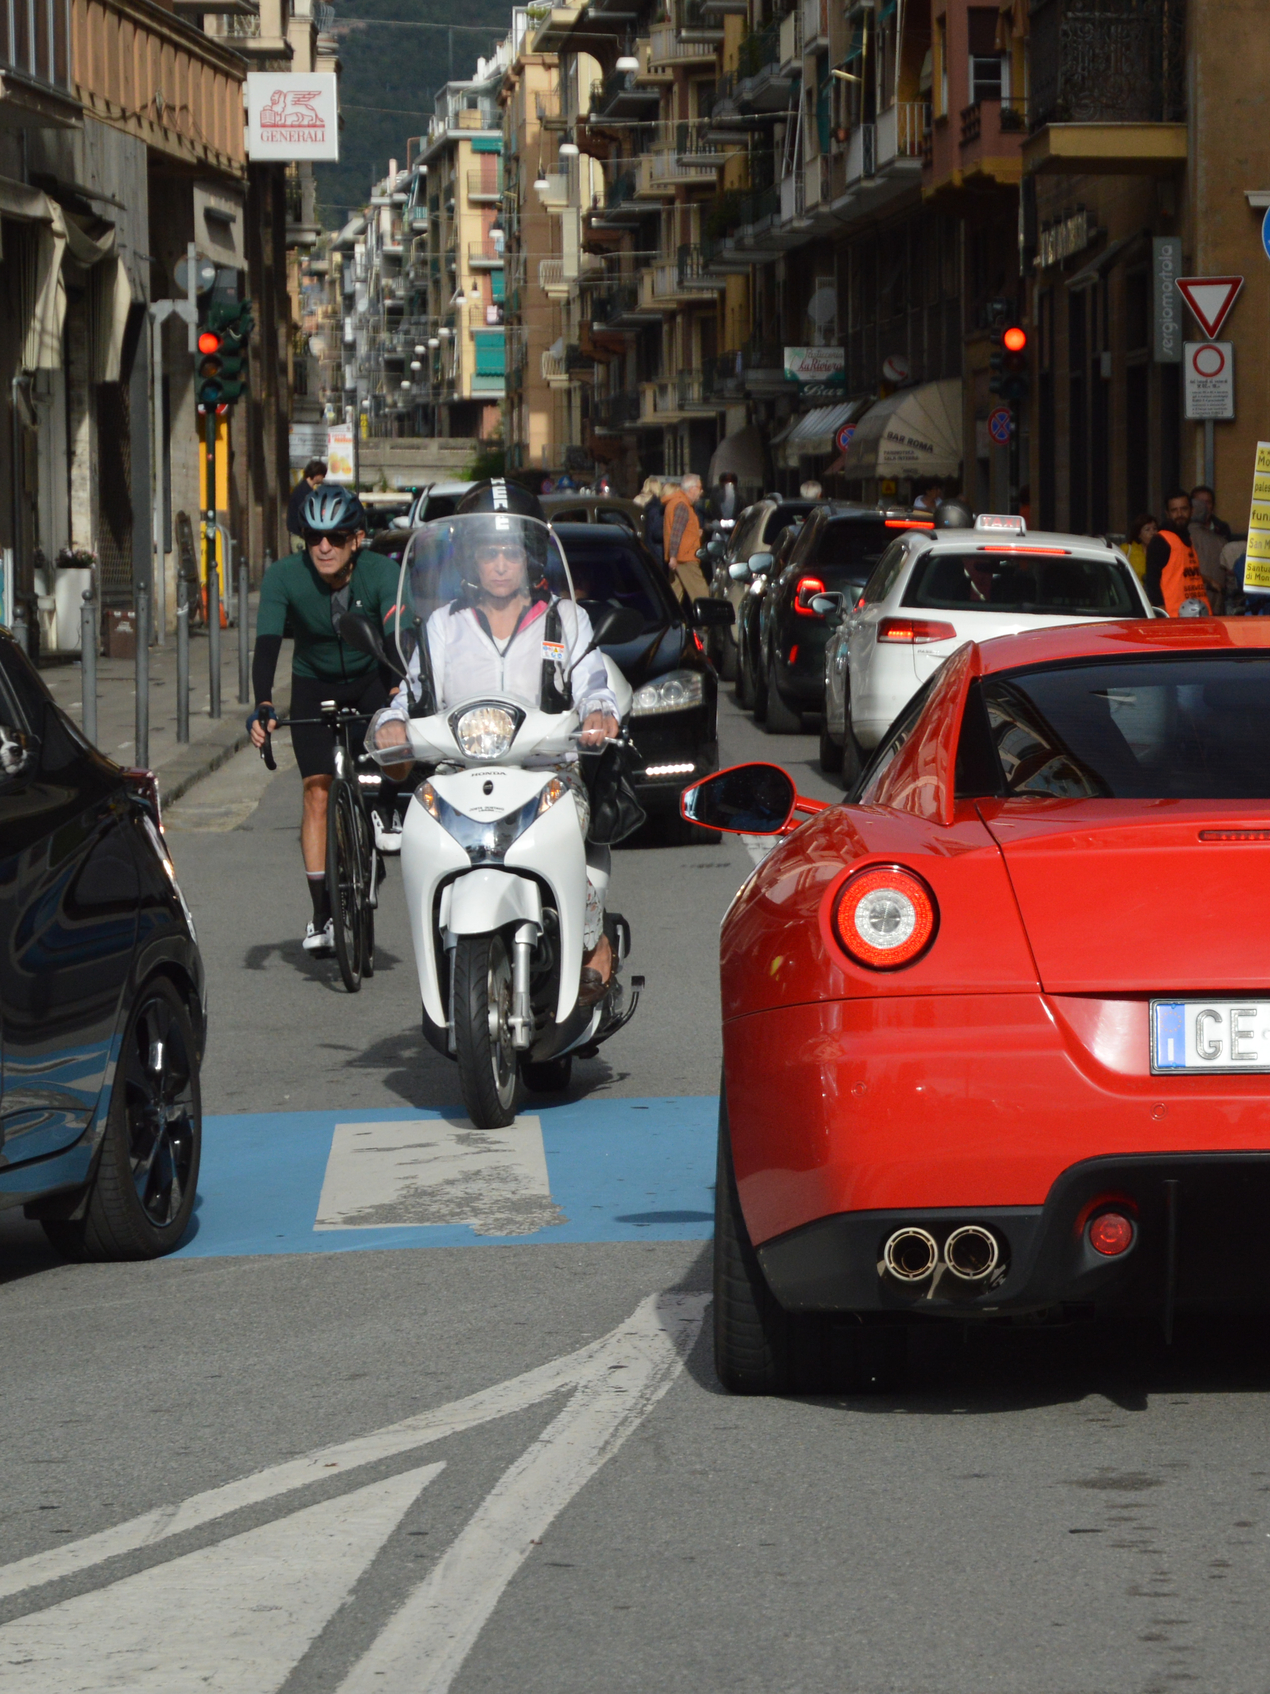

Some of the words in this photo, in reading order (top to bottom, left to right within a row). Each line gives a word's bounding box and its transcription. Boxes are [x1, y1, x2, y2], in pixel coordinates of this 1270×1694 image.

[261, 130, 325, 142] GENERALI
[1159, 244, 1178, 355] sergiomortola
[886, 431, 906, 442] BAR
[906, 437, 934, 453] ROMA
[982, 517, 1020, 528] TAXI
[1249, 538, 1263, 549] San
[1246, 572, 1253, 580] di
[1195, 1008, 1259, 1060] GE
